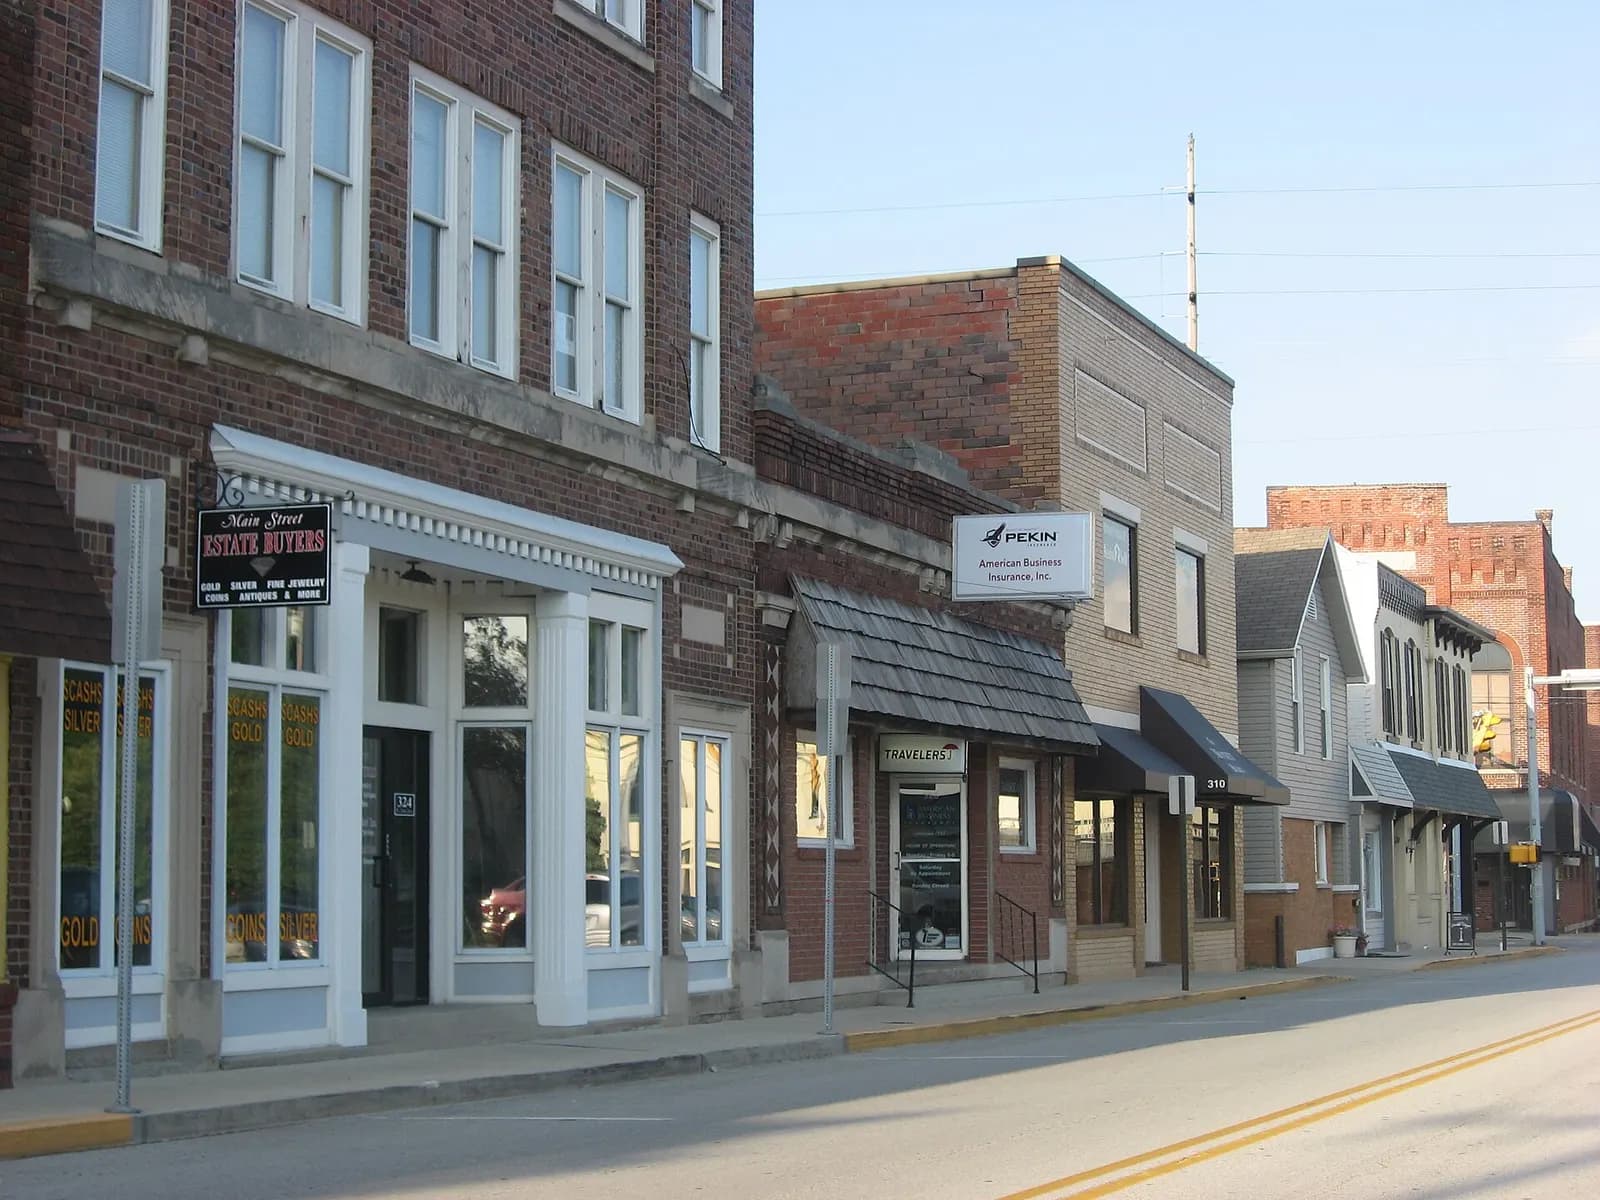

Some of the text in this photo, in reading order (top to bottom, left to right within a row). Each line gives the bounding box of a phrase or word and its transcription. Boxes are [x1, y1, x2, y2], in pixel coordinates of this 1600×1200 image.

[221, 511, 304, 529] Main Street
[202, 529, 325, 557] ESTATE BUYERS
[1005, 531, 1057, 543] PEKIN
[978, 557, 1062, 568] American Business
[988, 571, 1052, 582] Insurance, Inc.
[201, 578, 325, 592] GOLD SILVER FINE JEWELRY
[205, 590, 321, 602] COINS ANTIQUES & MORE
[65, 708, 101, 733] SILVER
[232, 722, 262, 742] GOLD
[286, 727, 314, 747] GOLD
[885, 749, 946, 760] TRAVELERS
[1207, 779, 1226, 789] 310
[396, 795, 412, 808] 324
[61, 915, 98, 947] GOLD
[227, 912, 266, 943] COINS
[280, 911, 318, 941] SILVER
